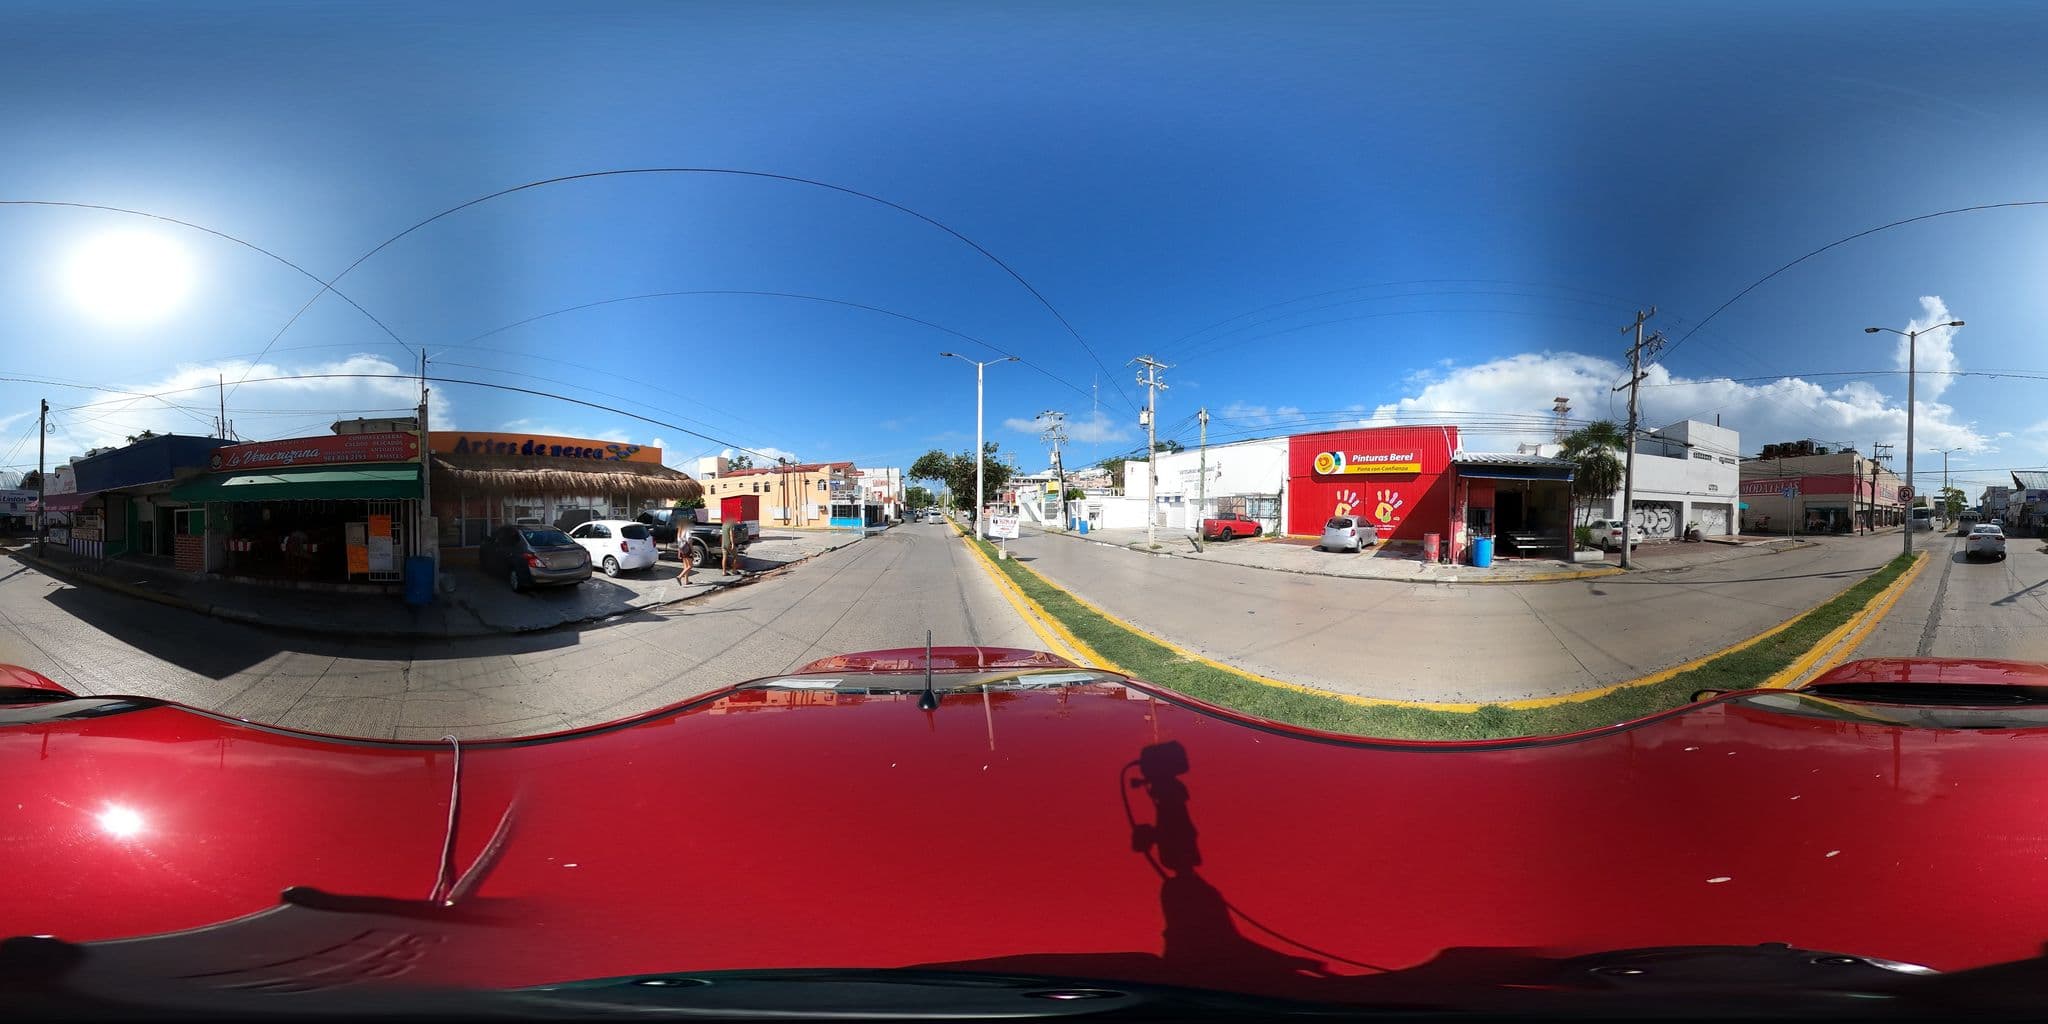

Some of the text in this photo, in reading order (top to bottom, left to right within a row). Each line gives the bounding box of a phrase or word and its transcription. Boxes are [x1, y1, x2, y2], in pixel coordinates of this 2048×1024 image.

[454, 436, 517, 455] Artes
[521, 439, 546, 456] de
[225, 448, 320, 467] La Veracruzana
[1352, 452, 1414, 463] Pinturas Berel
